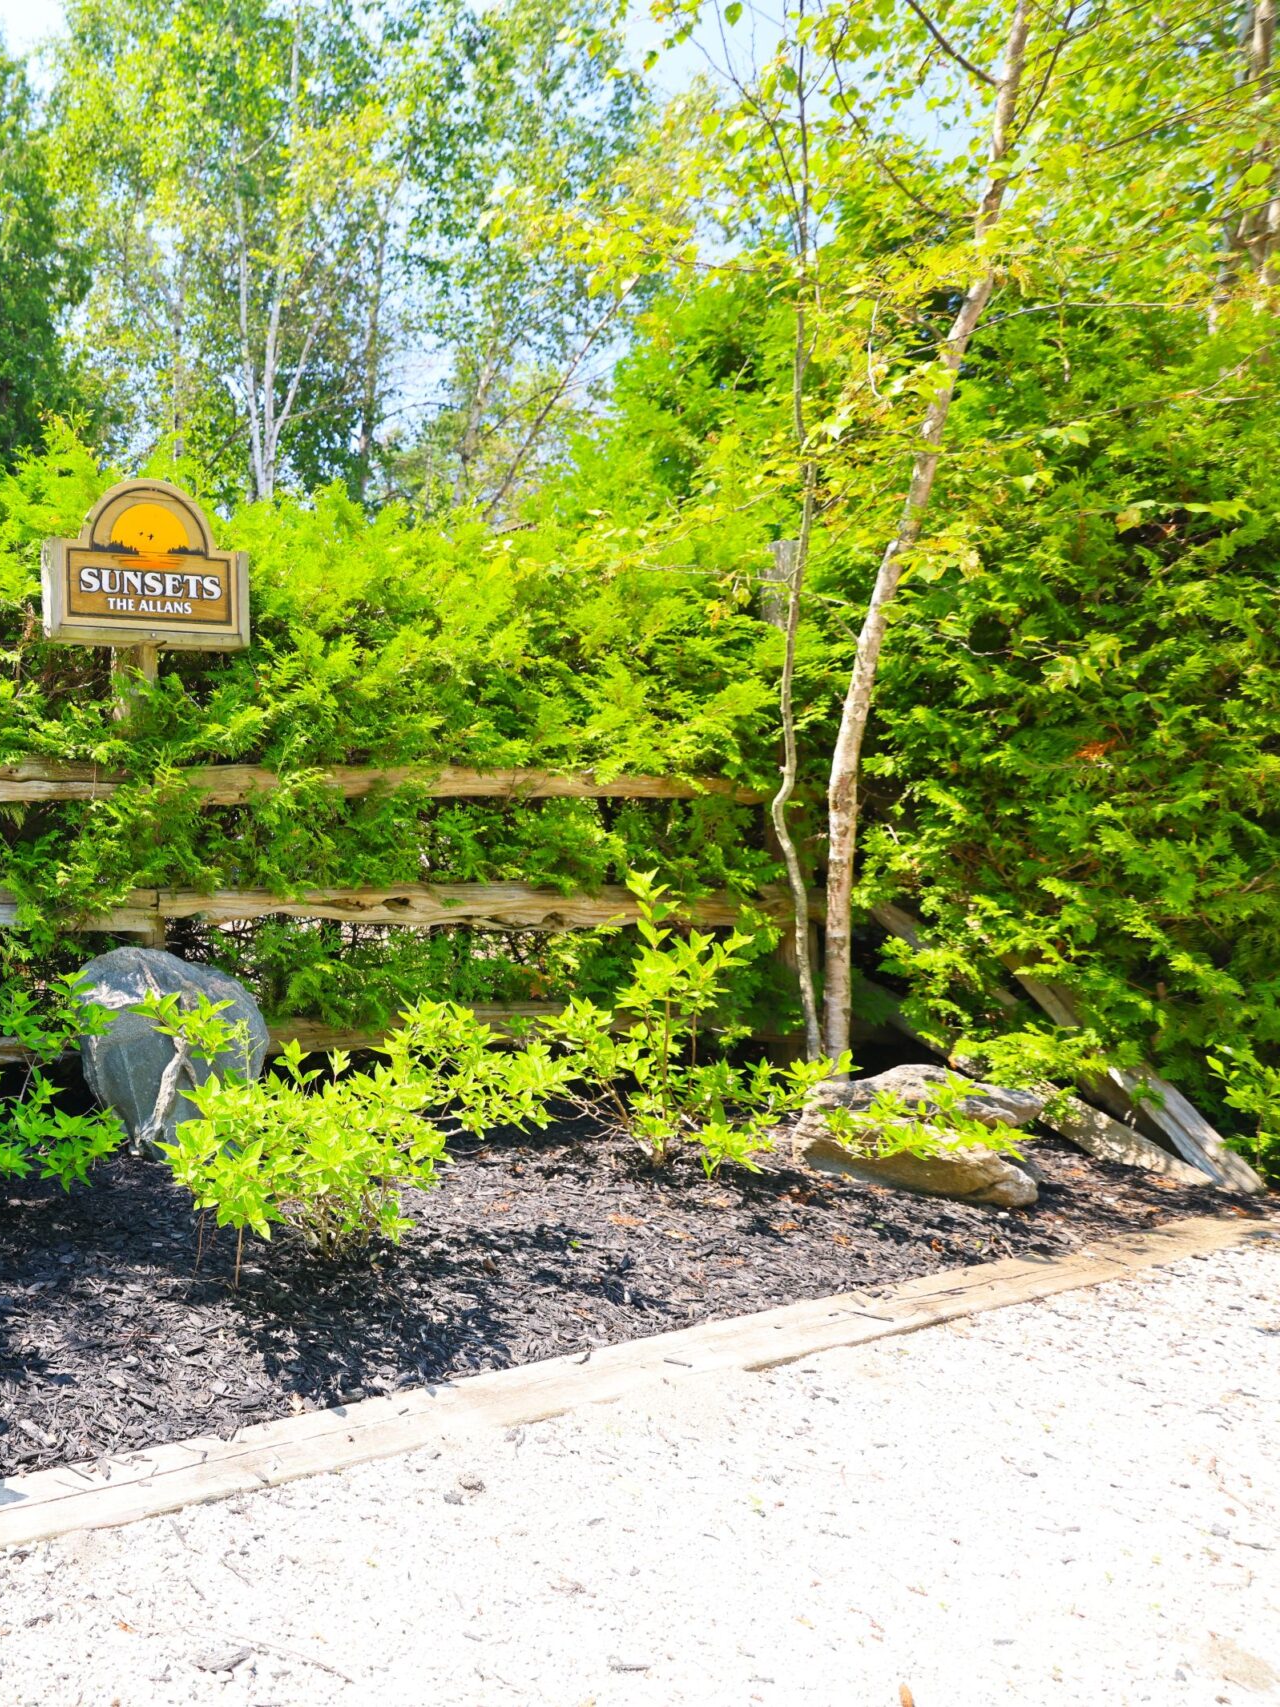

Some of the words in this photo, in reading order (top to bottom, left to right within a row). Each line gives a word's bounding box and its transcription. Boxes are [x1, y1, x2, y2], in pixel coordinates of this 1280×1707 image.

[80, 567, 222, 600] SUNSETS
[107, 597, 135, 611] THE
[139, 600, 192, 614] ALLANS
